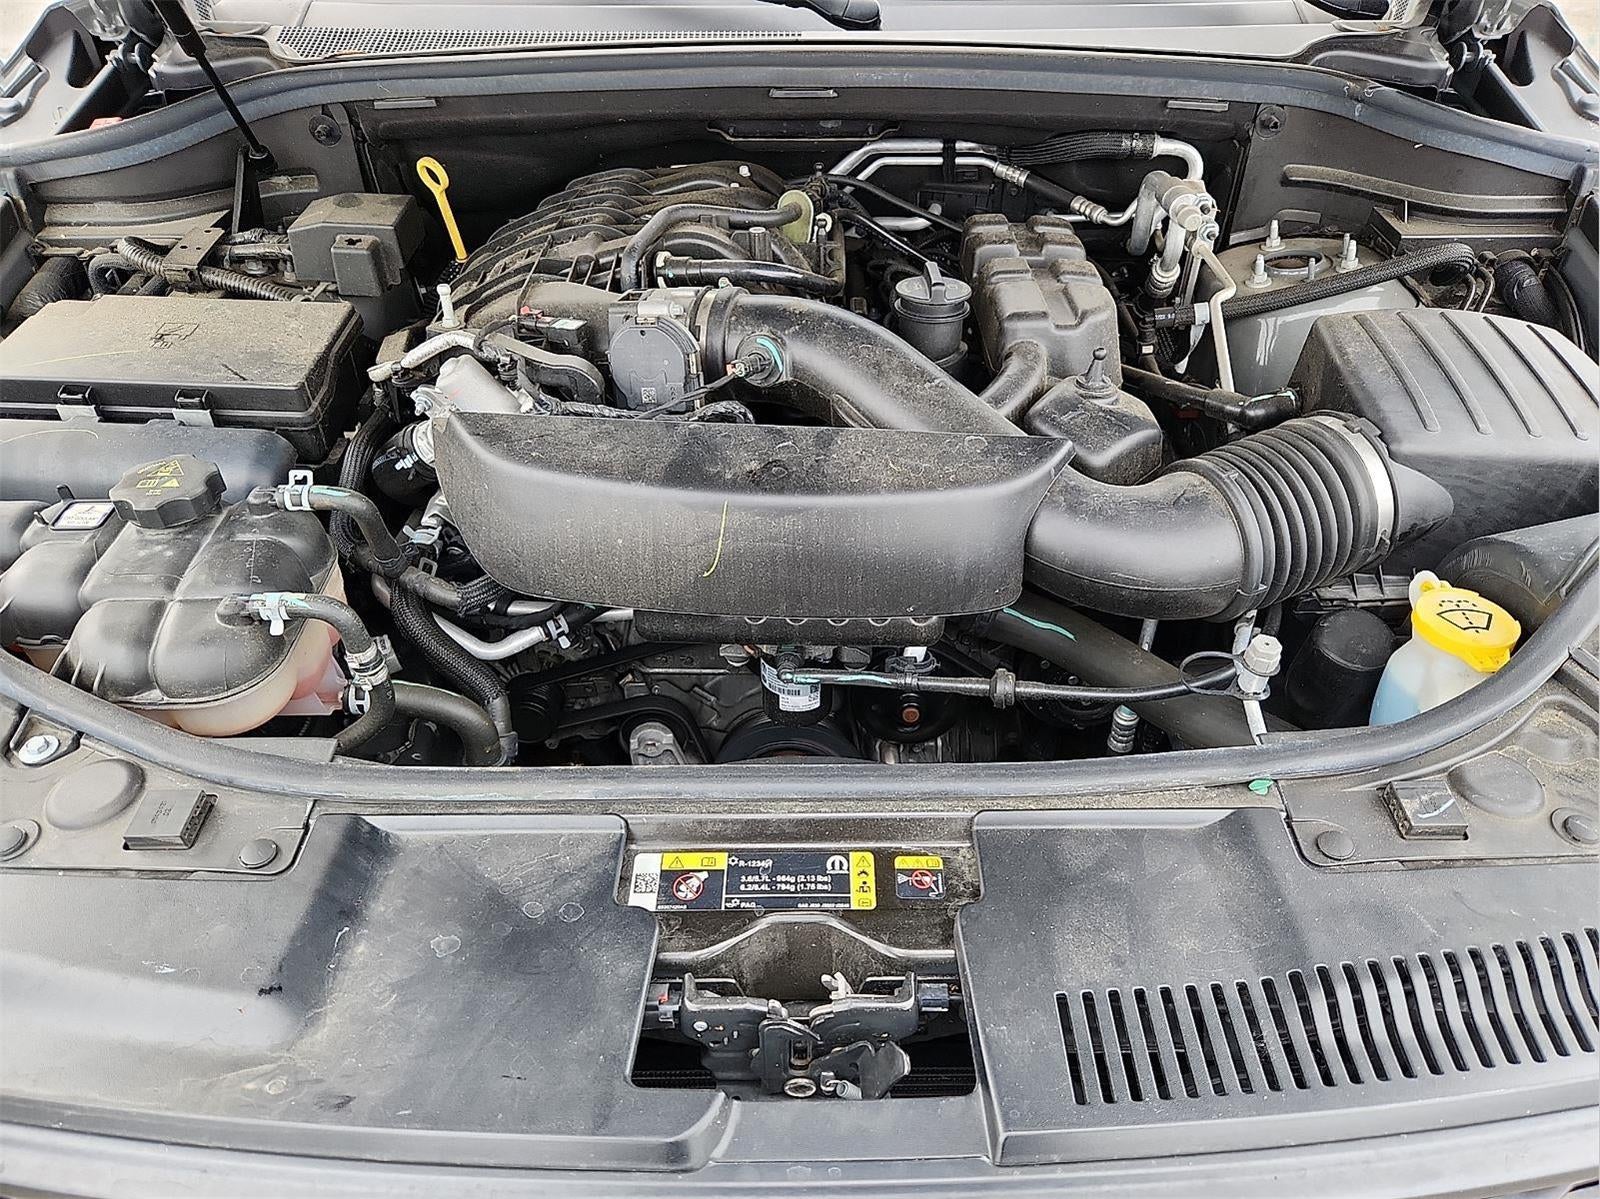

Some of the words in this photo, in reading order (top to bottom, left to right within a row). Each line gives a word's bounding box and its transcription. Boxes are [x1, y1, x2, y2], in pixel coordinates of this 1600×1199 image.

[797, 875, 816, 884] (2.13
[816, 875, 832, 884] lbs)
[816, 884, 832, 892] lbs)
